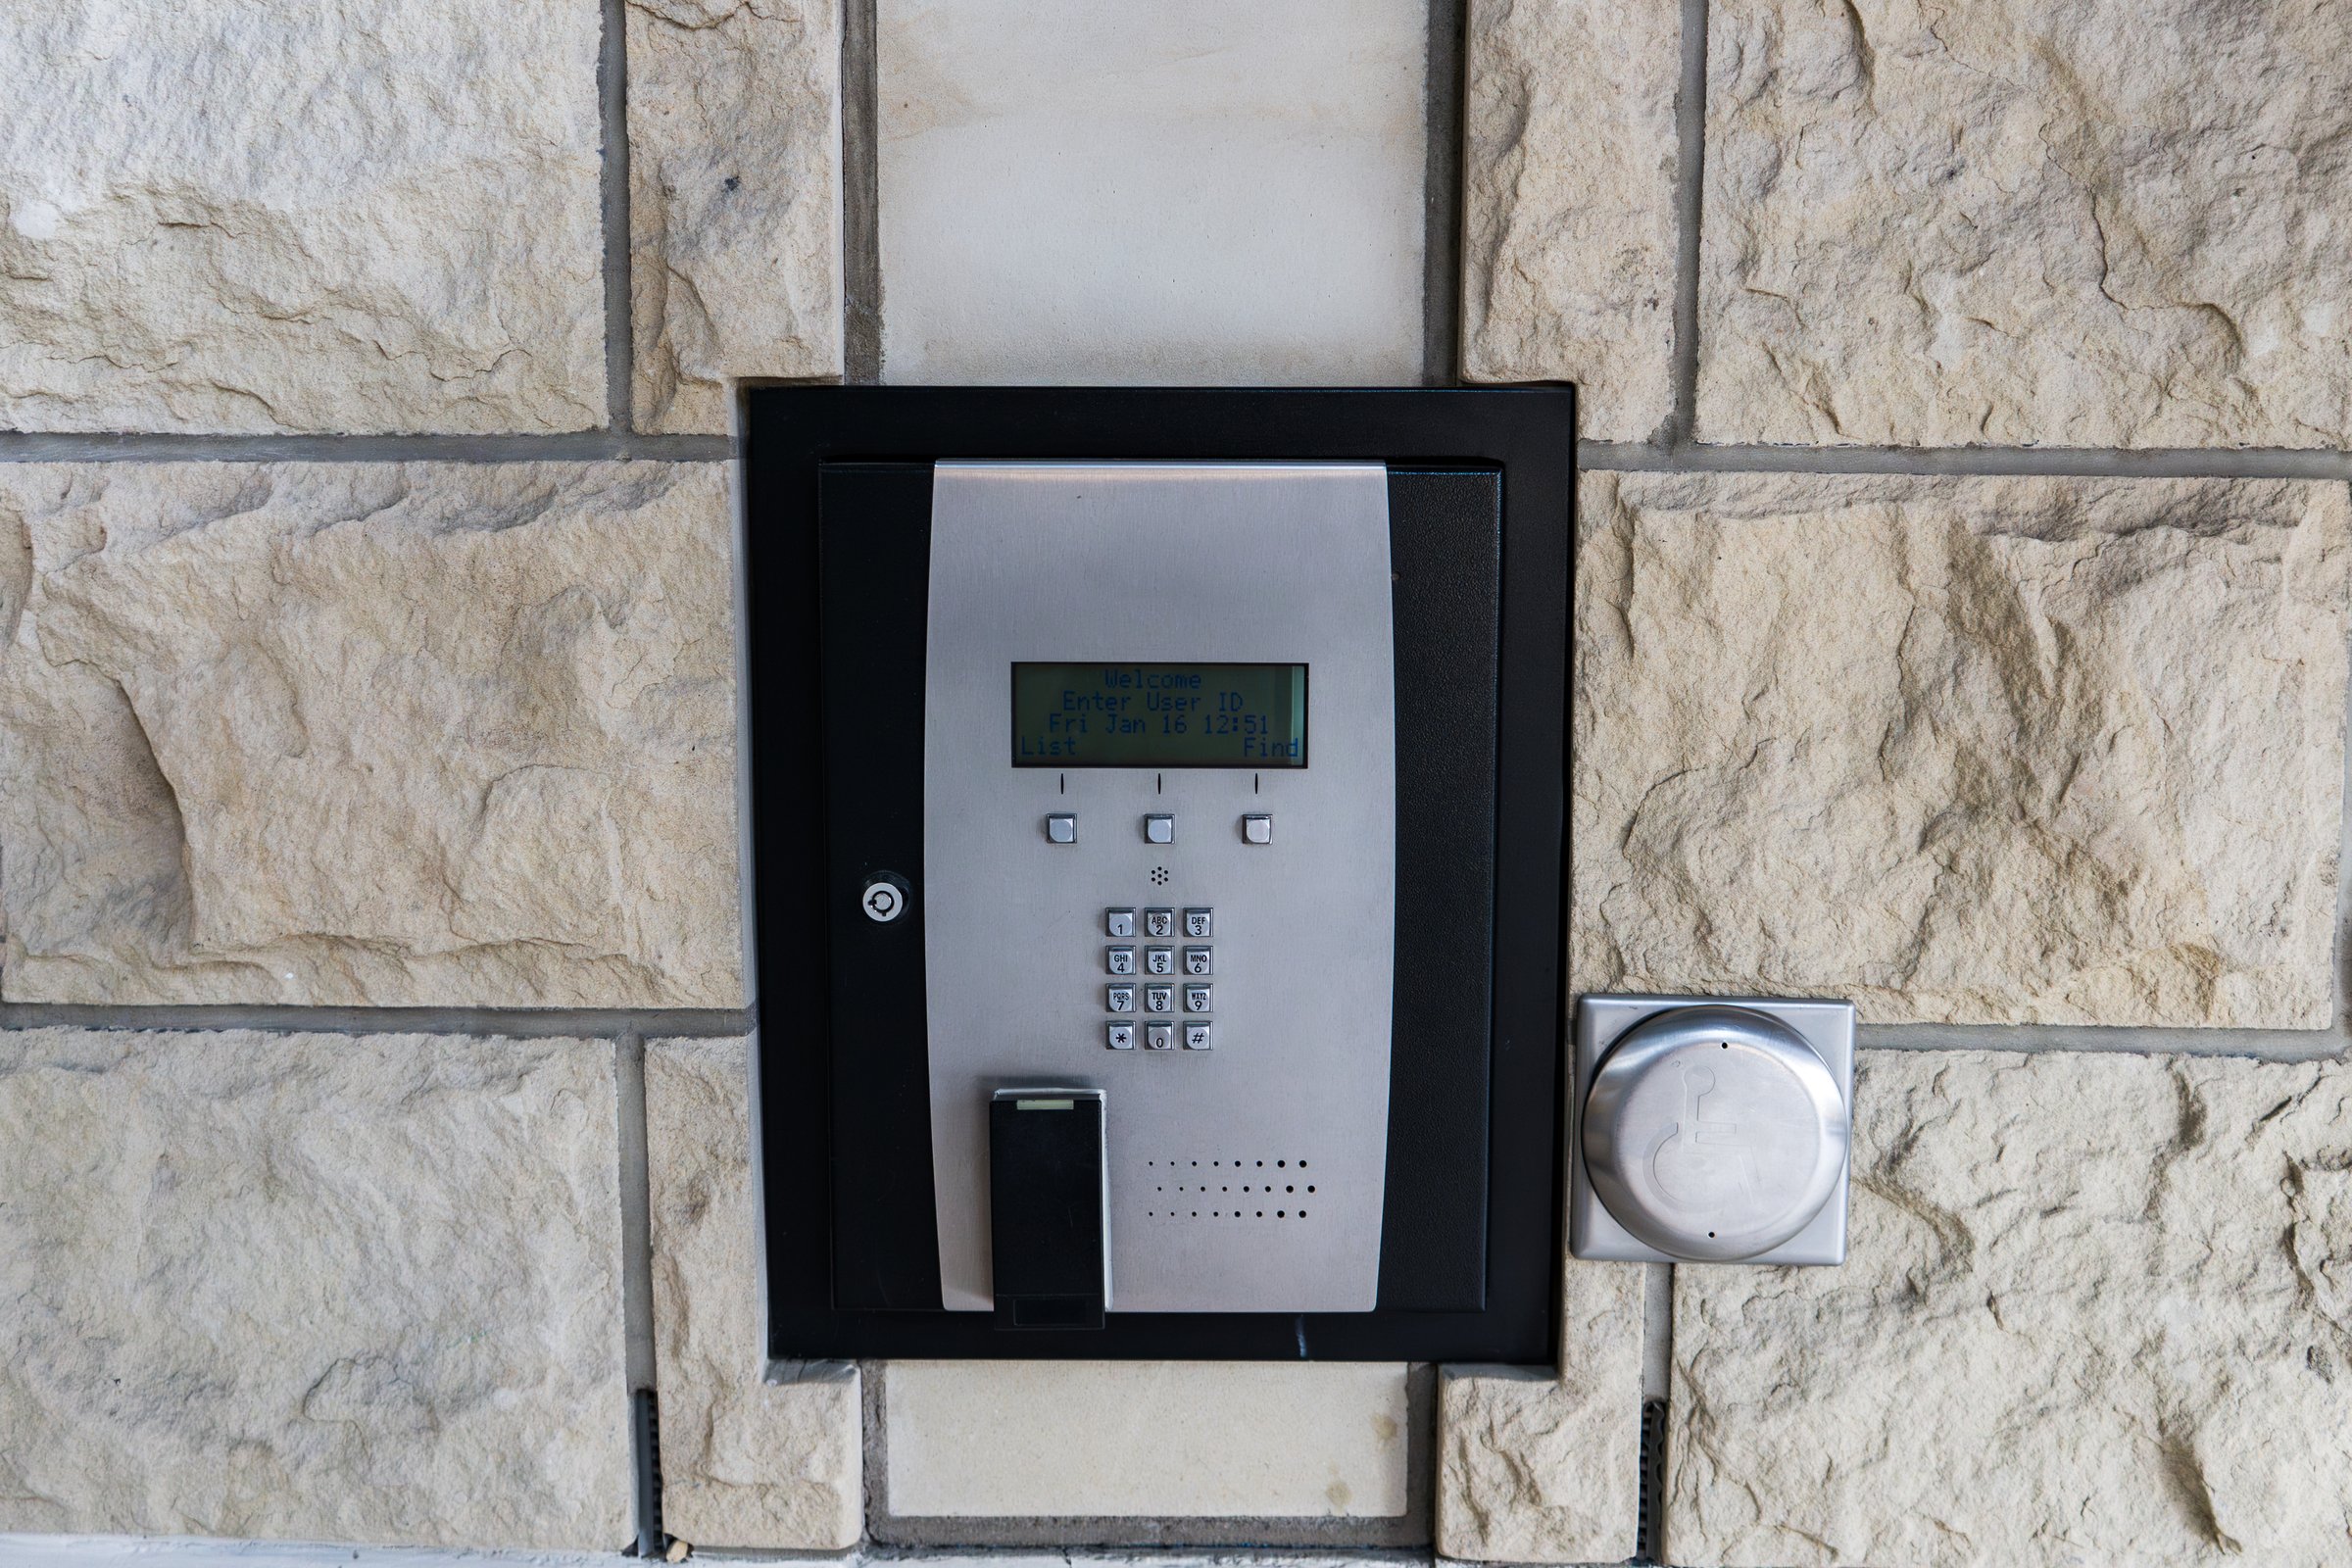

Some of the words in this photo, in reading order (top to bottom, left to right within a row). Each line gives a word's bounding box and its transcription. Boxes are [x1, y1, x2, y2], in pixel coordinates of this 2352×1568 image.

[1105, 669, 1201, 689] Welcome
[1063, 691, 1131, 710] Enter
[1147, 692, 1200, 710] User
[1219, 692, 1243, 711] ID
[1050, 713, 1087, 733] Fri
[1105, 714, 1146, 733] Jan
[1162, 715, 1187, 733] 16
[1204, 715, 1268, 734] 12:51
[1021, 737, 1077, 756] List
[1244, 738, 1298, 758] Find
[1191, 916, 1206, 925] DEF
[1117, 924, 1123, 935] 1
[1155, 925, 1163, 936] 2
[1195, 925, 1202, 936] 3
[1116, 963, 1125, 973] 4
[1156, 963, 1164, 973] 5
[1194, 963, 1202, 973] 6
[1112, 992, 1130, 1001] PQRS
[1152, 992, 1167, 1001] TUV
[1116, 1001, 1125, 1010] 7
[1155, 1001, 1163, 1010] 8
[1195, 1001, 1202, 1010] 9
[1155, 1038, 1163, 1049] 0
